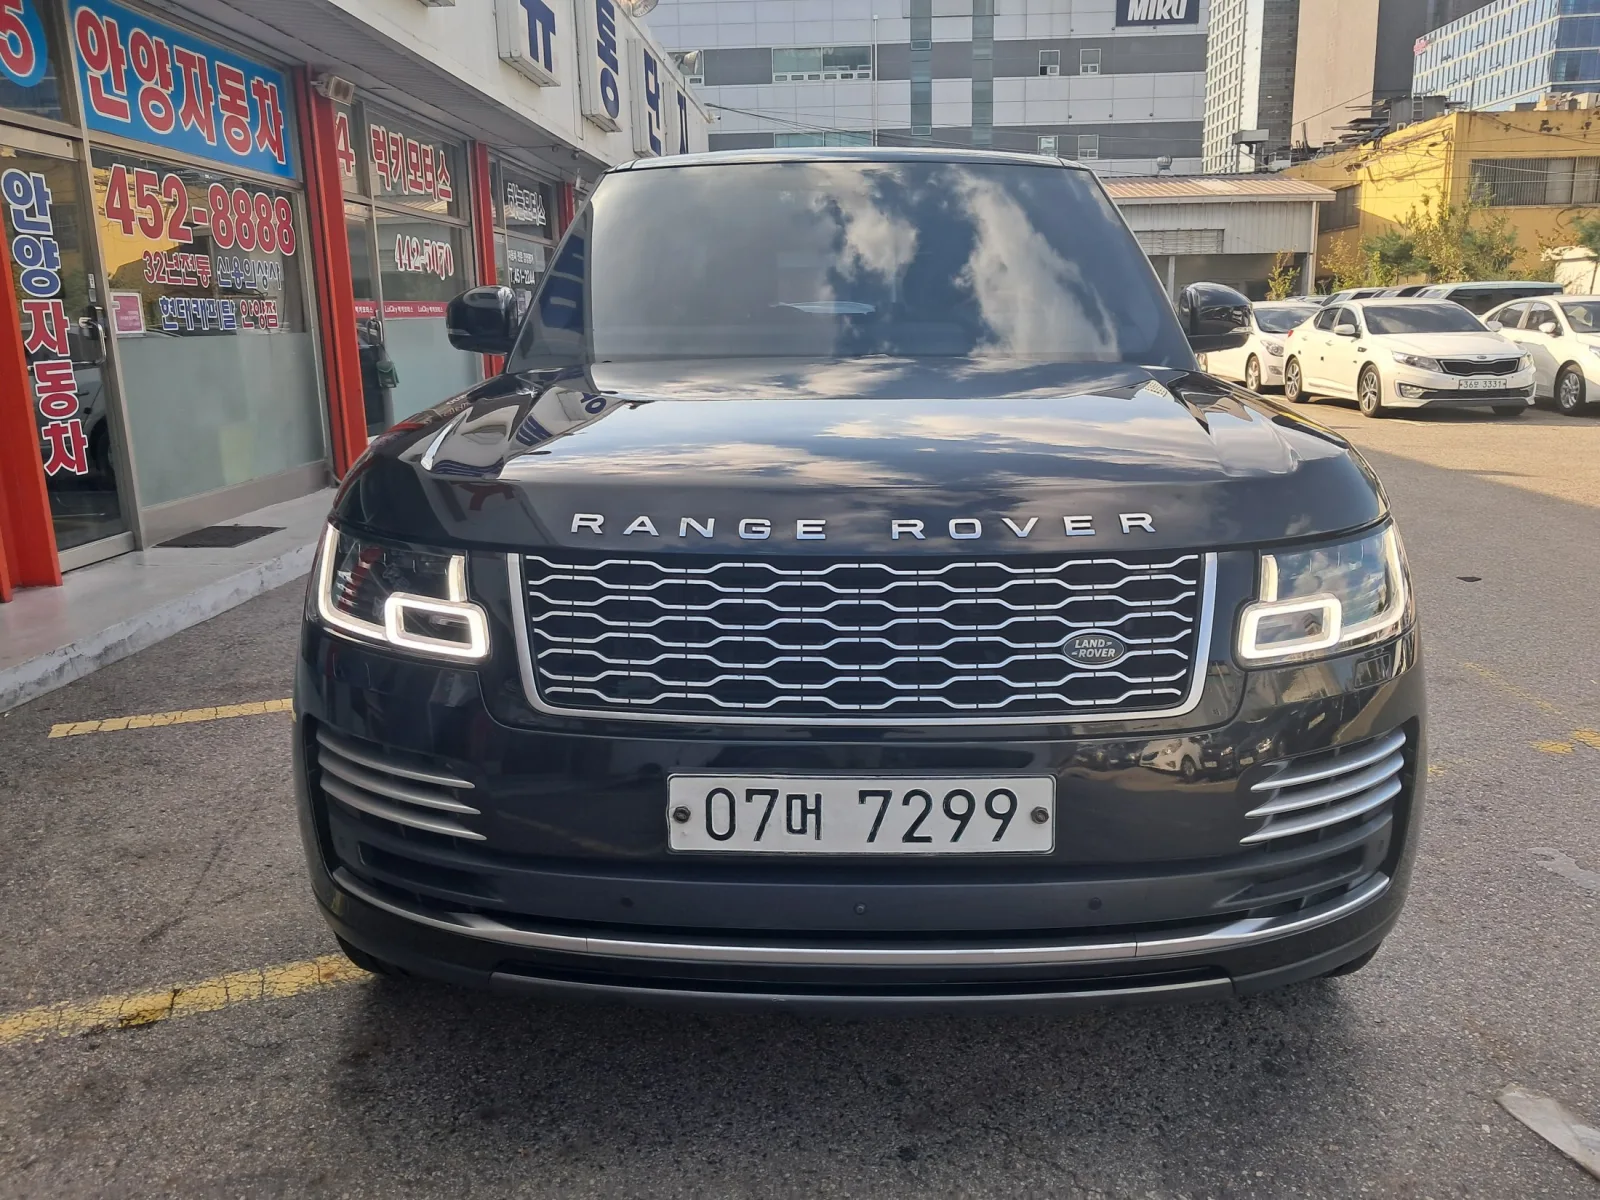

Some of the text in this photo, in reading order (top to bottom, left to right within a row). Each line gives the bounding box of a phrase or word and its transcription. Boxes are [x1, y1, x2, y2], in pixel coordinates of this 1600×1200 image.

[75, 6, 286, 164] 안양자동차
[370, 124, 452, 202] 럭키모터스
[105, 163, 295, 255] 452-8888
[143, 250, 211, 288] 32년전통
[395, 233, 454, 281] 442-5070
[1, 168, 88, 475] 안양자동차
[159, 296, 237, 330] 현대캐피탈
[240, 300, 279, 329] 안양점
[570, 511, 1157, 541] RANGE ROVER
[1074, 639, 1106, 648] LAND
[1078, 648, 1116, 658] ROVER
[705, 787, 1018, 843] 07머 7299
